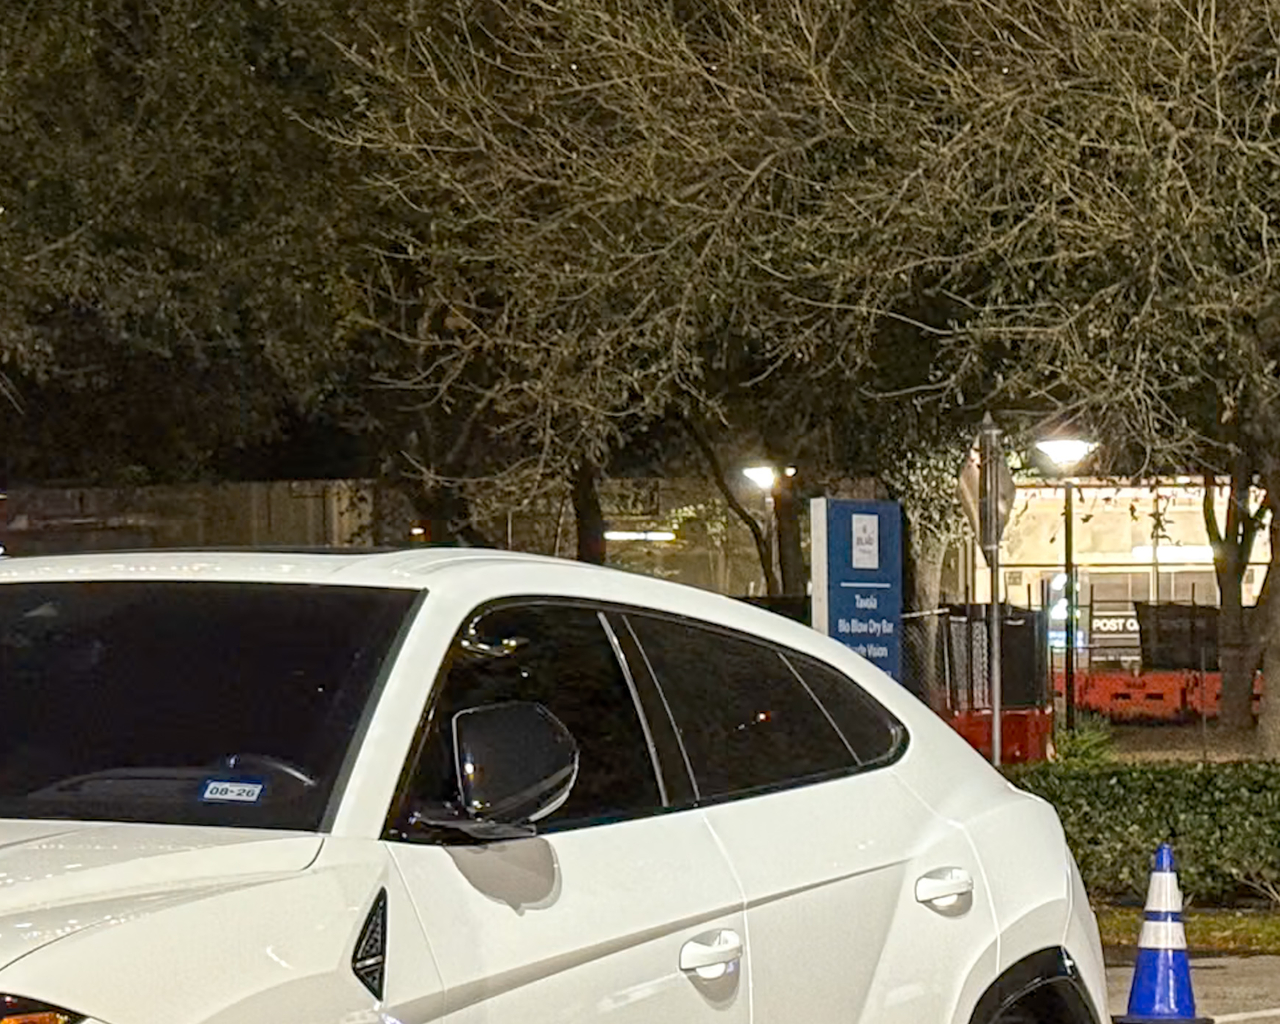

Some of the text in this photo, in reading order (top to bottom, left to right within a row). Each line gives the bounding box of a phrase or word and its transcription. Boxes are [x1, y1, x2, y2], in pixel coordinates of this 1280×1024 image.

[869, 619, 881, 637] Dry
[882, 619, 894, 633] Bar
[1093, 618, 1124, 631] POST
[209, 786, 255, 797] 08-26
